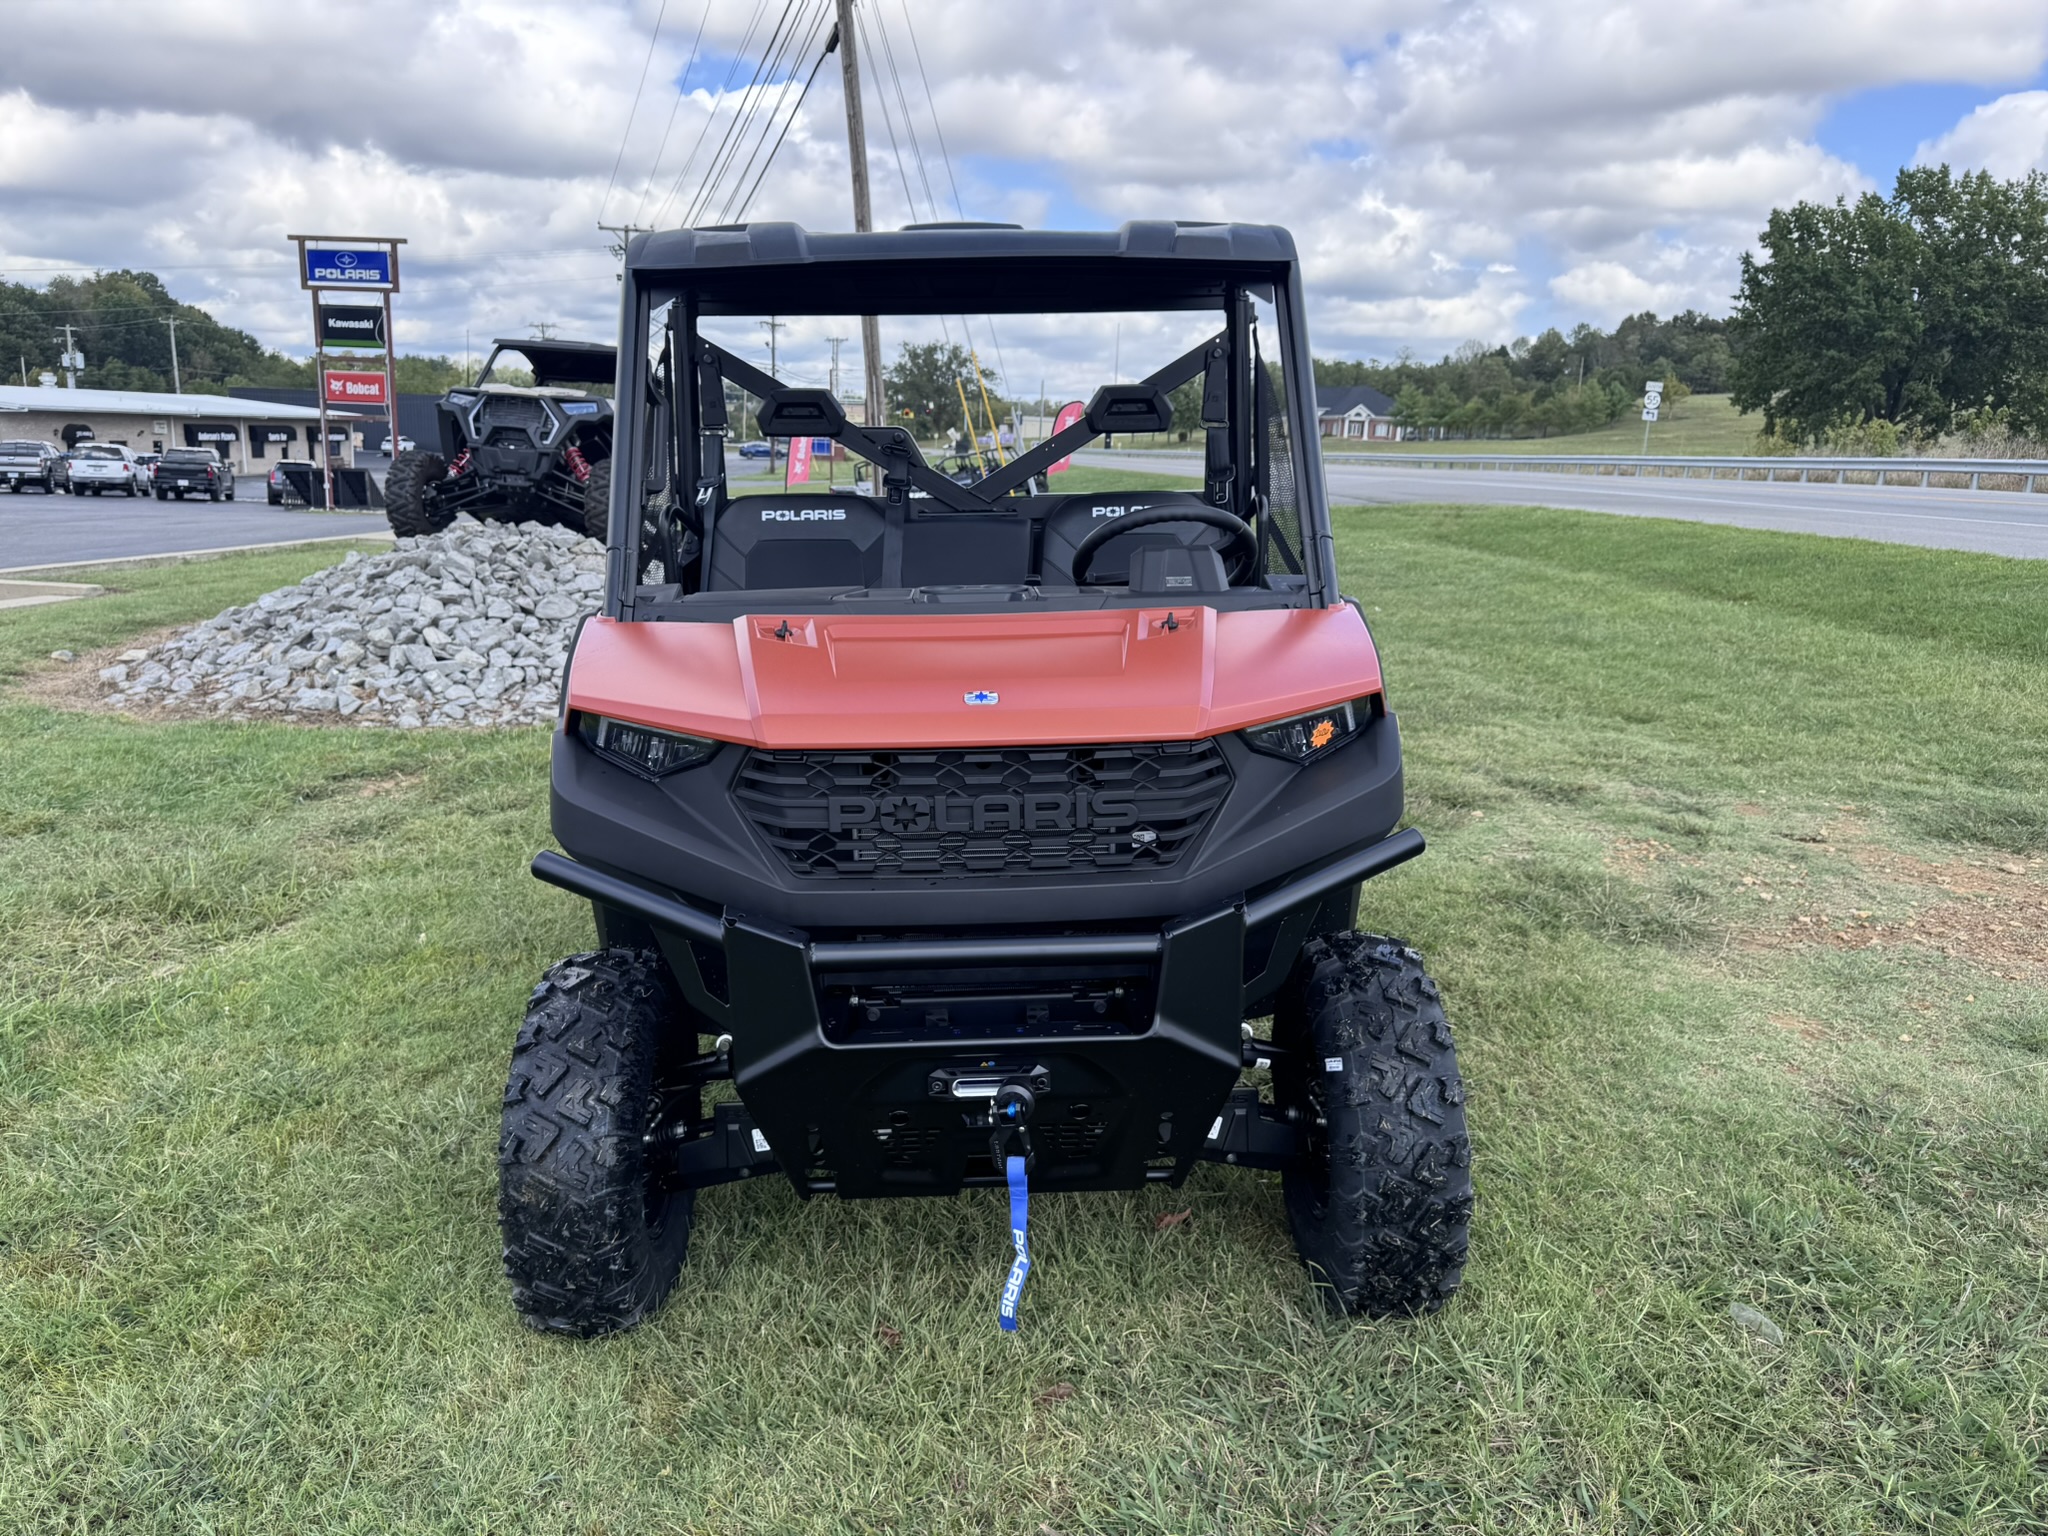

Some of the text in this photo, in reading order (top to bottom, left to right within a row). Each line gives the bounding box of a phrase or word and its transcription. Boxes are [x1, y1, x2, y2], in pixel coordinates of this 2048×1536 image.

[314, 267, 381, 281] POLARIS
[328, 318, 374, 329] Kawasaki
[345, 381, 380, 396] Bobcat
[1646, 395, 1659, 406] 55
[761, 508, 847, 521] POLARIS
[828, 789, 1139, 833] POLARIS
[1001, 1227, 1028, 1319] POLARIS
